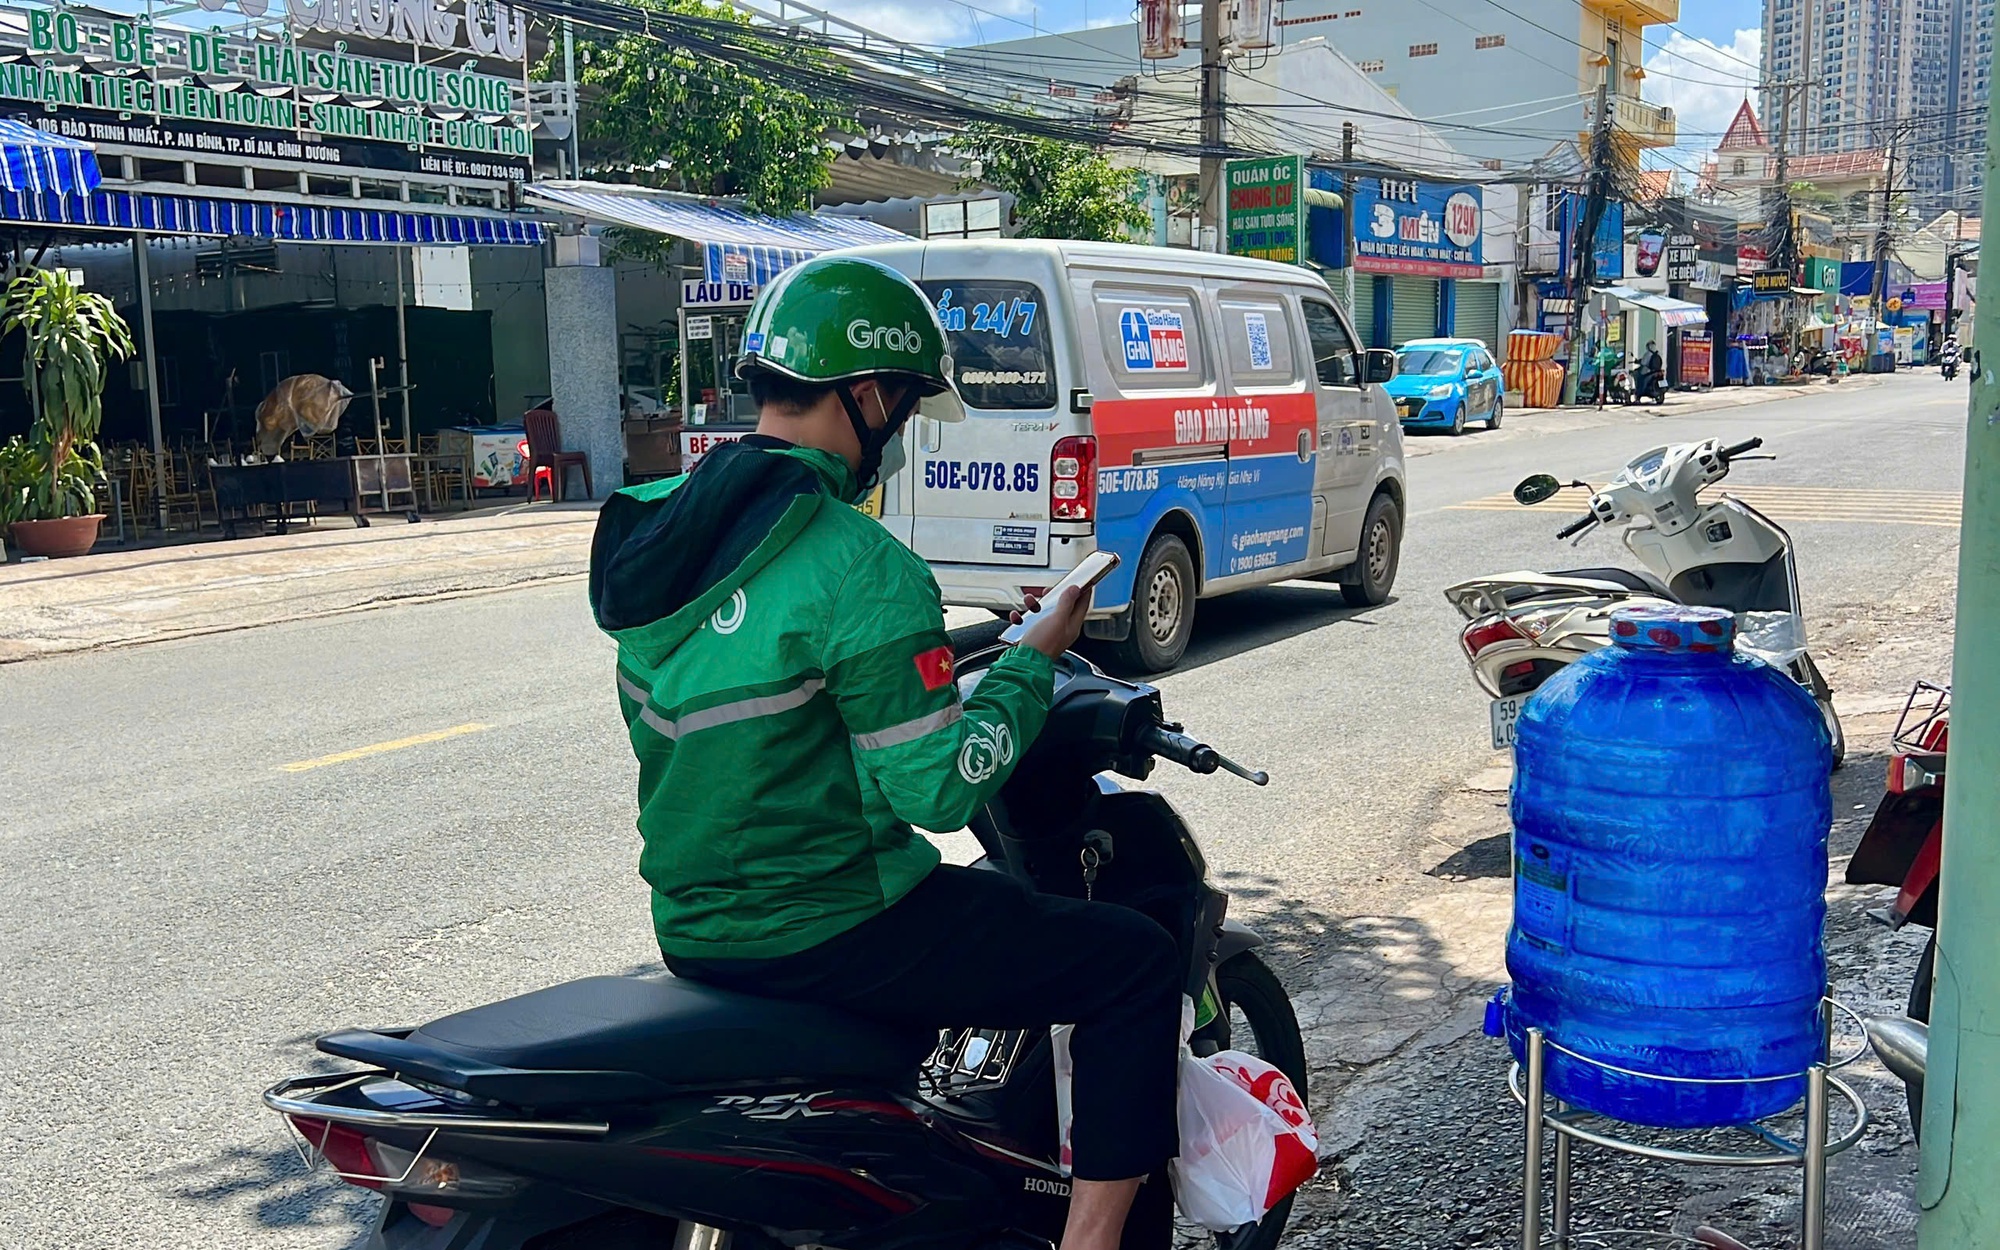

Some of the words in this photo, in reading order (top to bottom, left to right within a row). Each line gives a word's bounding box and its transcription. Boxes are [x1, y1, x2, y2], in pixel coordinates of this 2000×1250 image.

[111, 13, 156, 67] BÊ
[188, 25, 229, 75] DÊ
[256, 30, 309, 87] HẢI
[315, 41, 372, 96] SẢN
[380, 63, 438, 104] TƯƠI
[445, 59, 510, 114] SỐNG
[0, 59, 84, 112] NHẬN
[90, 68, 152, 121] TIỆC
[158, 76, 217, 119] LIÊN
[222, 91, 293, 128] HOAN
[312, 102, 368, 137] SINH
[374, 107, 429, 152] NHẬT
[36, 118, 59, 134] 106
[61, 117, 87, 137] ĐÀO
[88, 123, 125, 141] TRINH
[128, 125, 163, 146] NHẤT,
[164, 131, 176, 146] P.
[177, 132, 194, 148] AN
[226, 137, 243, 153] TP.
[257, 141, 276, 157] AN,
[277, 140, 302, 158] BÌNH
[420, 156, 440, 171] LIÊN
[442, 158, 454, 176] HỆ
[470, 163, 491, 177] 0907
[1232, 166, 1269, 185] QUÁN
[1272, 161, 1291, 181] ỐC
[1230, 186, 1272, 210] CHUNG
[1275, 183, 1293, 207] CƯ
[1370, 203, 1396, 238] 3
[1452, 203, 1476, 237] 129K
[1668, 250, 1679, 263] XE
[1668, 267, 1678, 280] XE
[971, 297, 1038, 338] 24/7
[847, 318, 922, 354] Grab
[1152, 331, 1185, 367] NẶNG
[1126, 341, 1150, 361] GHN
[1174, 409, 1202, 444] GIAO
[1204, 401, 1236, 442] HÀNG
[1239, 398, 1269, 446] NẶNG
[689, 433, 709, 454] BÊ
[925, 460, 1039, 492] 50E-078.85
[1098, 469, 1159, 494] 50E-078.85
[1239, 526, 1304, 551] giaohangnang.com
[1237, 555, 1253, 571] 1900
[1024, 1177, 1073, 1197] HOND
